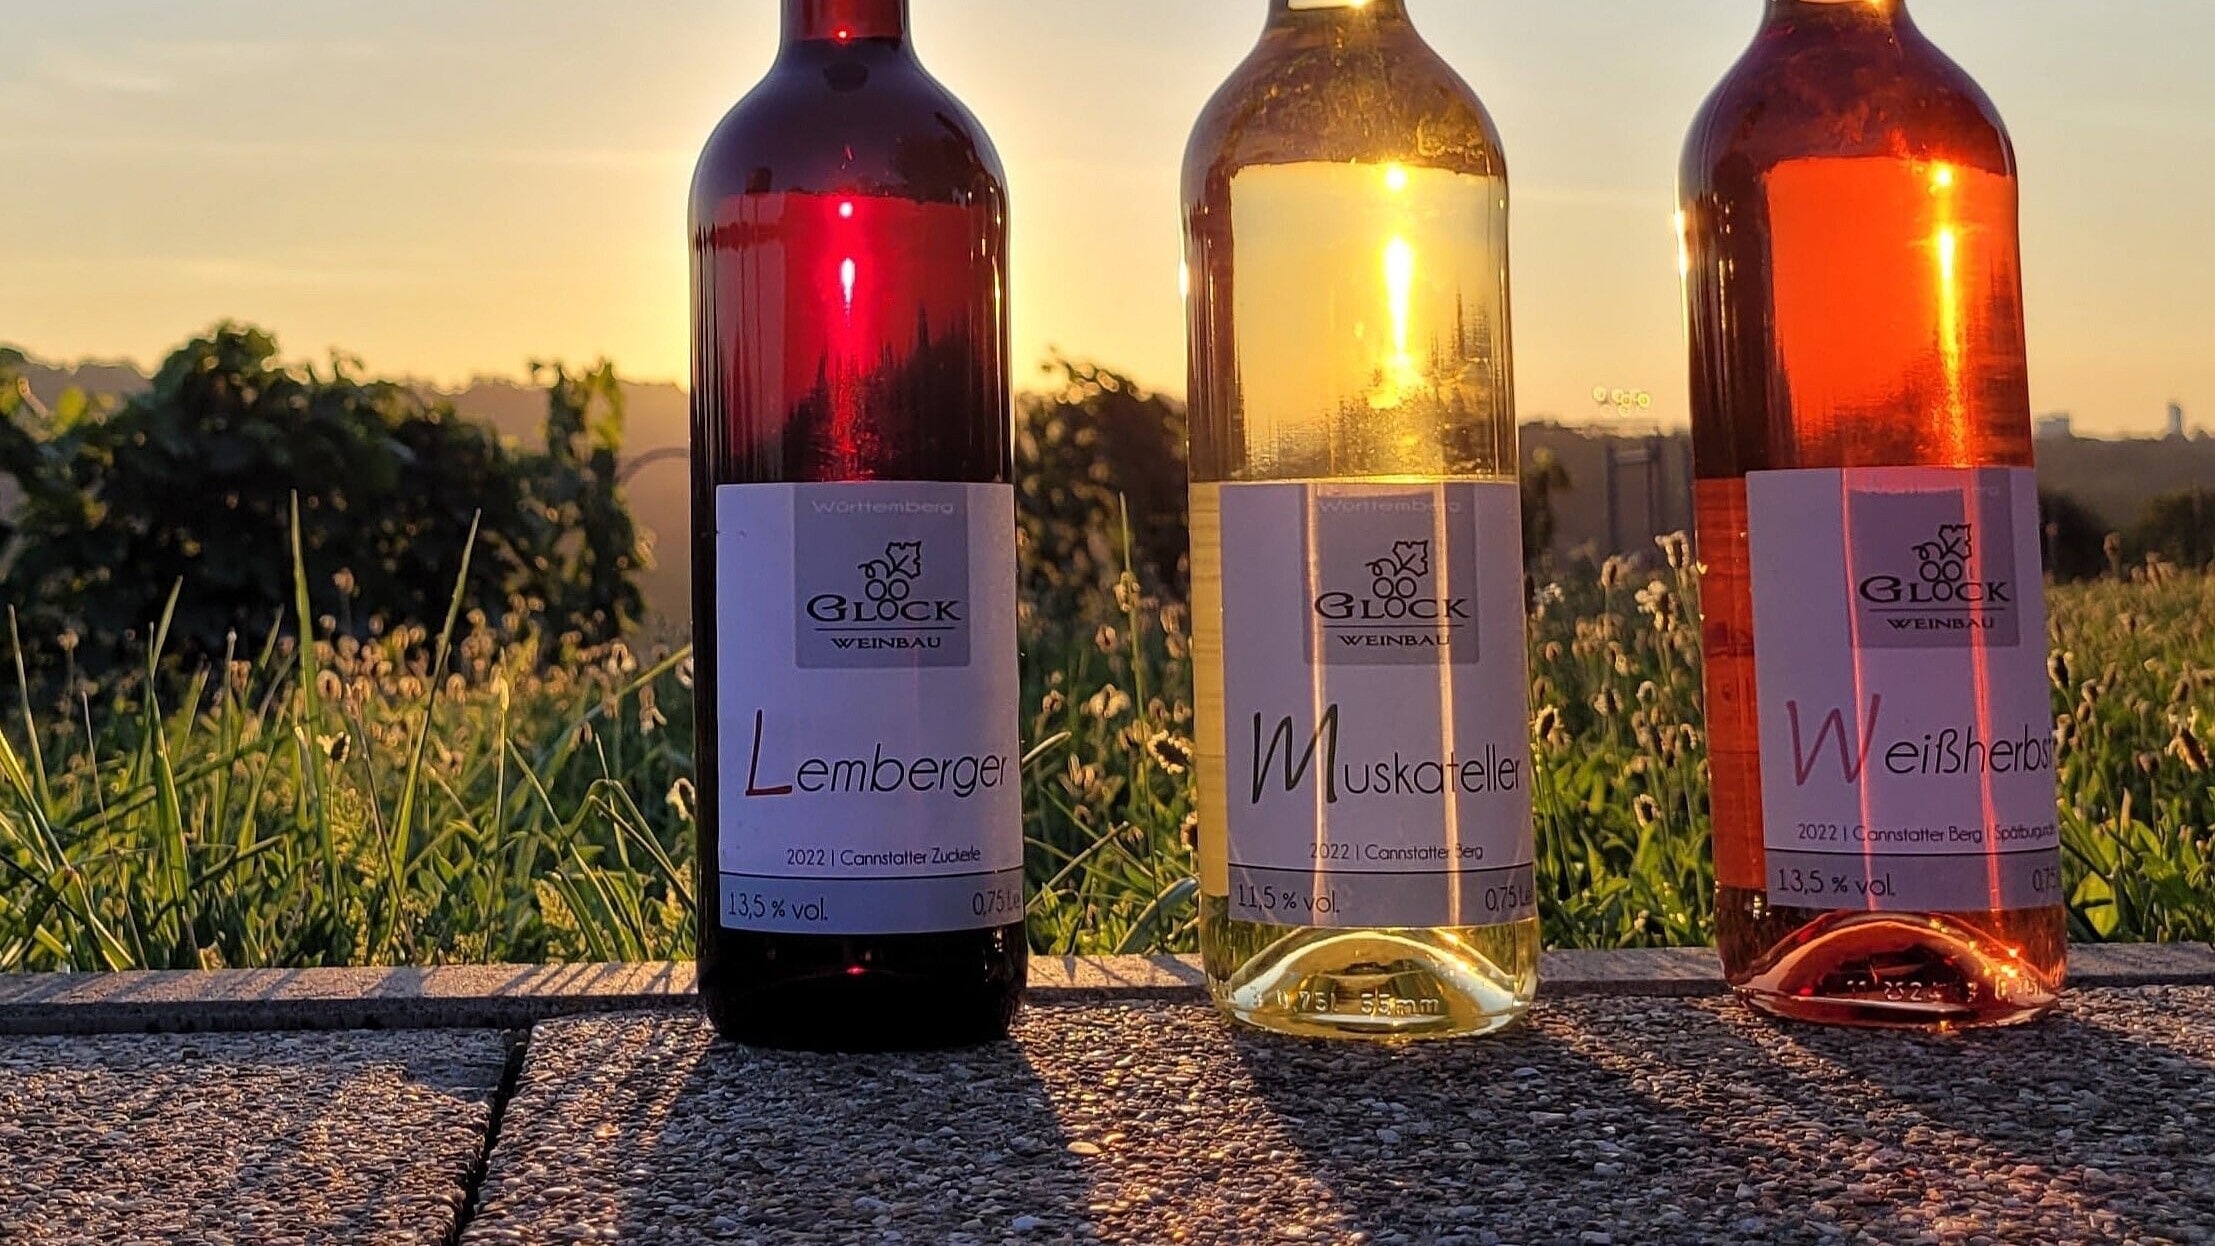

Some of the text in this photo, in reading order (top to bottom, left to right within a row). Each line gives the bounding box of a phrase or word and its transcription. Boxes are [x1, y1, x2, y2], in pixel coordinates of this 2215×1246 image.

[1886, 617, 1995, 631] WEINBAU
[831, 636, 942, 650] WEINBAU
[1337, 634, 1451, 647] WEINBAU
[745, 708, 1008, 798] Lemberger
[1251, 703, 1520, 804] Muskateller
[1797, 823, 1838, 841] 2022
[1852, 824, 1946, 843] Cannstatter
[1948, 825, 1983, 844] Berg
[786, 847, 826, 866] 2022
[839, 848, 928, 867] Cannstatter
[1310, 842, 1350, 860] 2022
[1364, 842, 1450, 861] Cannstatter
[1777, 867, 1825, 896] 13,5
[1854, 872, 1897, 897] vol.
[727, 891, 767, 920] 13,5
[791, 897, 829, 922] vol.
[1237, 883, 1277, 911] 11,5
[1302, 890, 1341, 913] vol.
